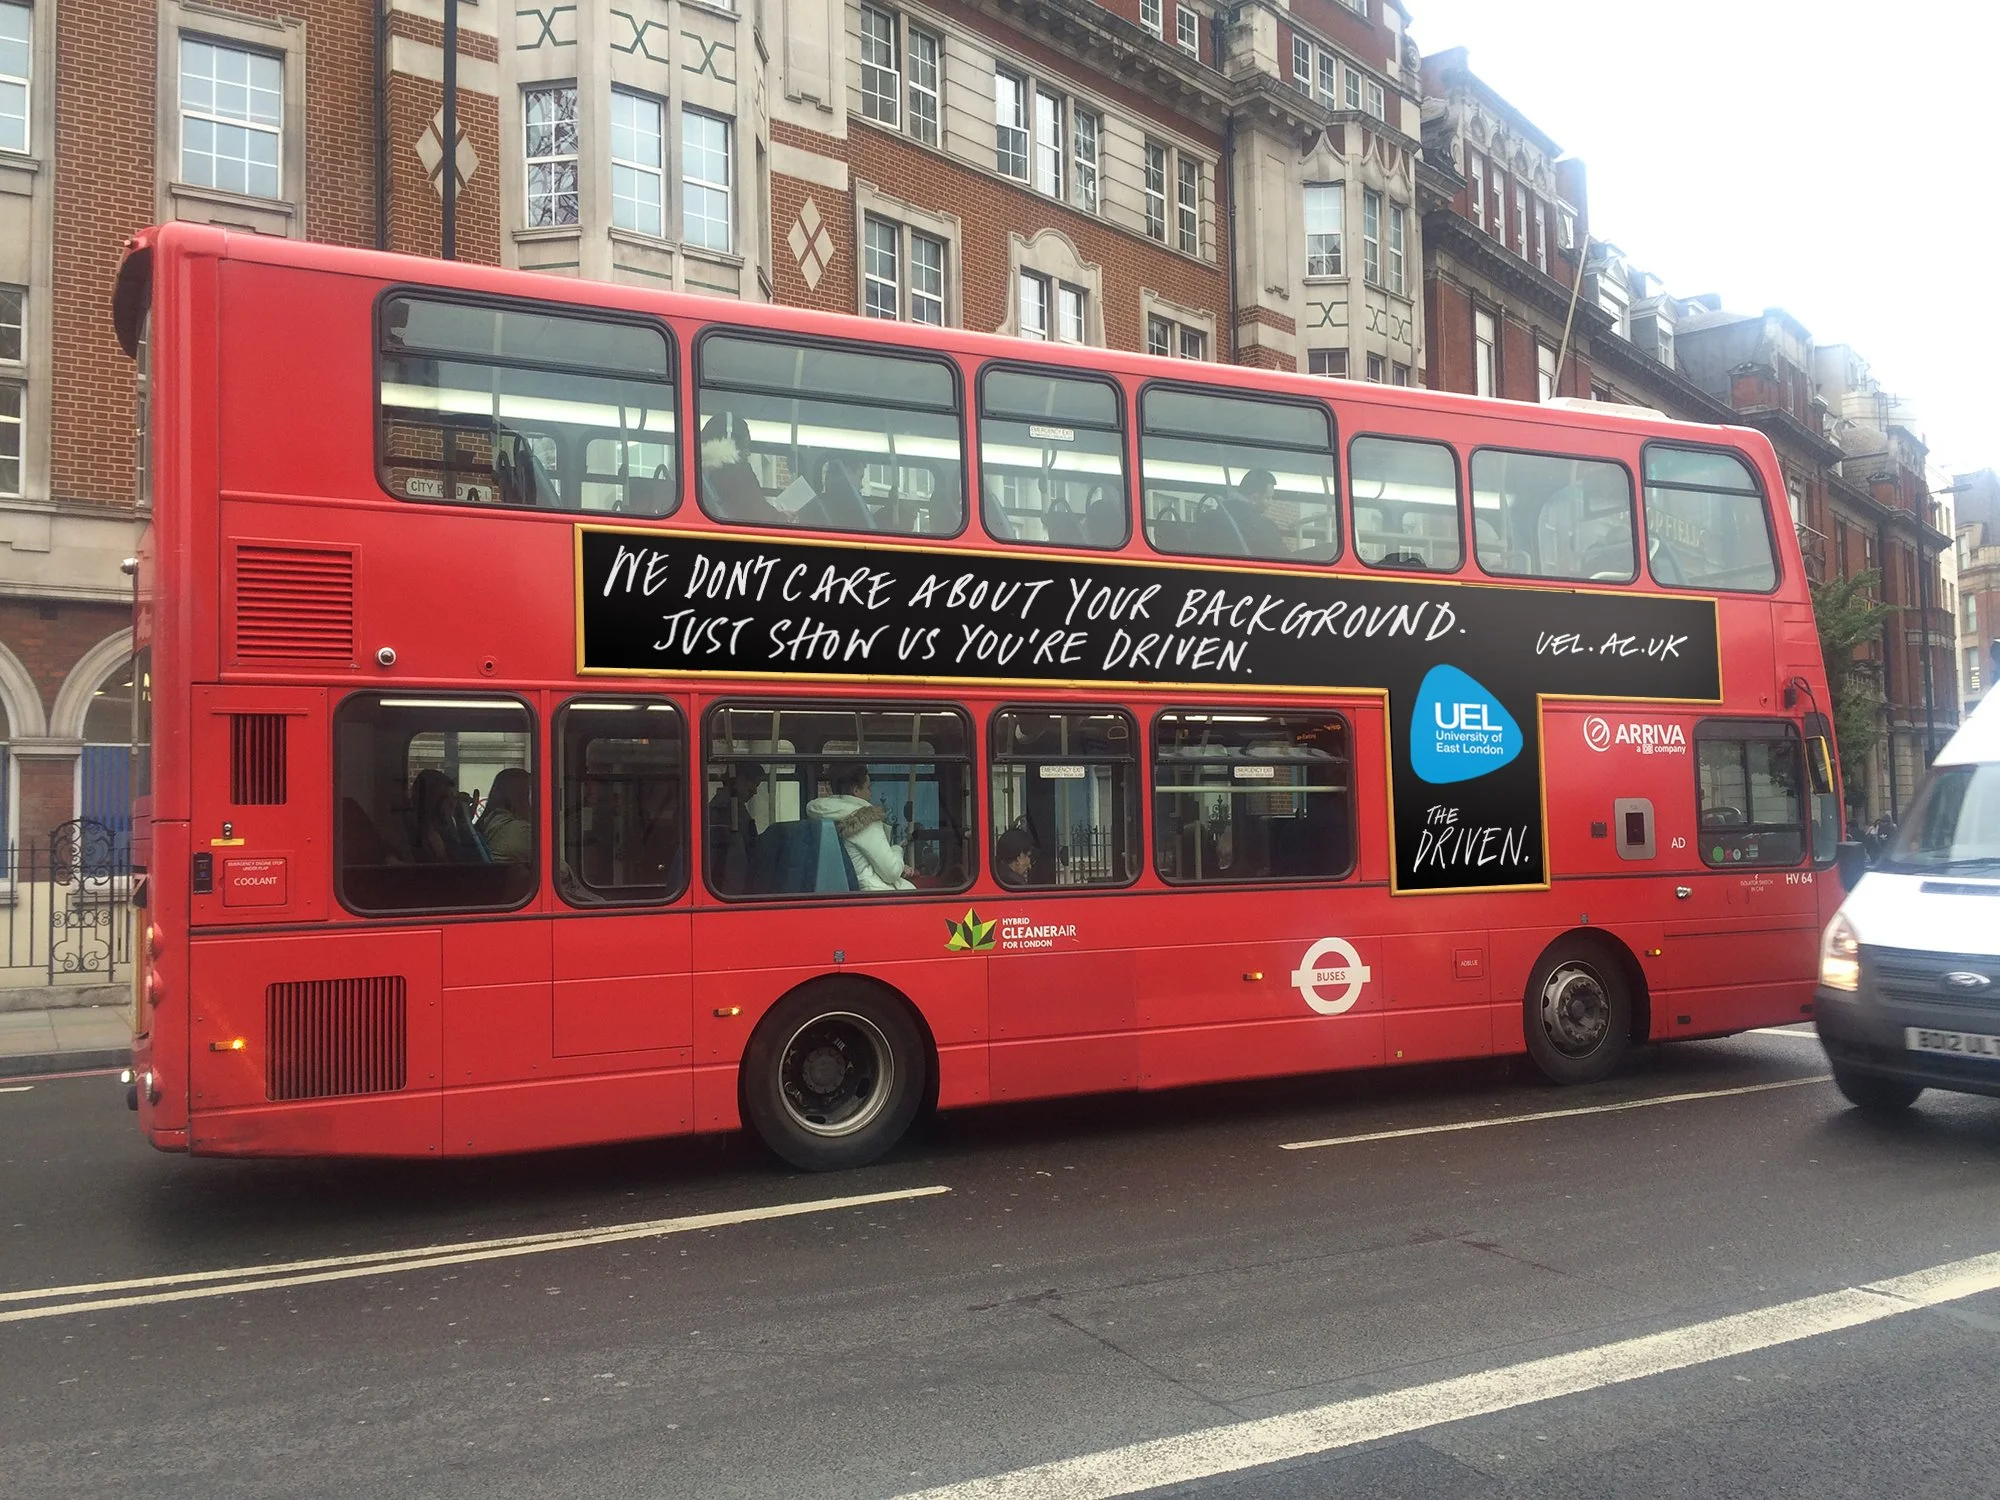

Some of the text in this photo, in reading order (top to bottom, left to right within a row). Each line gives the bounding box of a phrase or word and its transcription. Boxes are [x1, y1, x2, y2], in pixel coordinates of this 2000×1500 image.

[411, 480, 433, 493] CITY
[437, 483, 463, 497] RD
[604, 545, 1467, 641] WE DON'T CARE ABOUT YOUR BACKGROUND.
[653, 609, 1253, 674] JUST SHOW US YOU'RE DRIVEN.
[1536, 632, 1688, 661] UEL.AC.UK
[1434, 702, 1503, 731] UEL
[1435, 730, 1503, 744] University of
[1615, 723, 1686, 745] ARRIVA
[1436, 742, 1504, 755] East London
[1654, 745, 1687, 755] company
[1427, 805, 1459, 825] THE
[1413, 825, 1530, 873] DRIVEN.
[1671, 837, 1686, 849] AD
[233, 876, 278, 886] COOLANT
[1785, 872, 1813, 885] HV 64
[1002, 917, 1030, 926] HYBRID
[1002, 924, 1077, 939] CLEANERAIR
[1002, 939, 1053, 949] FOR LONDON
[1316, 971, 1346, 982] BUSES
